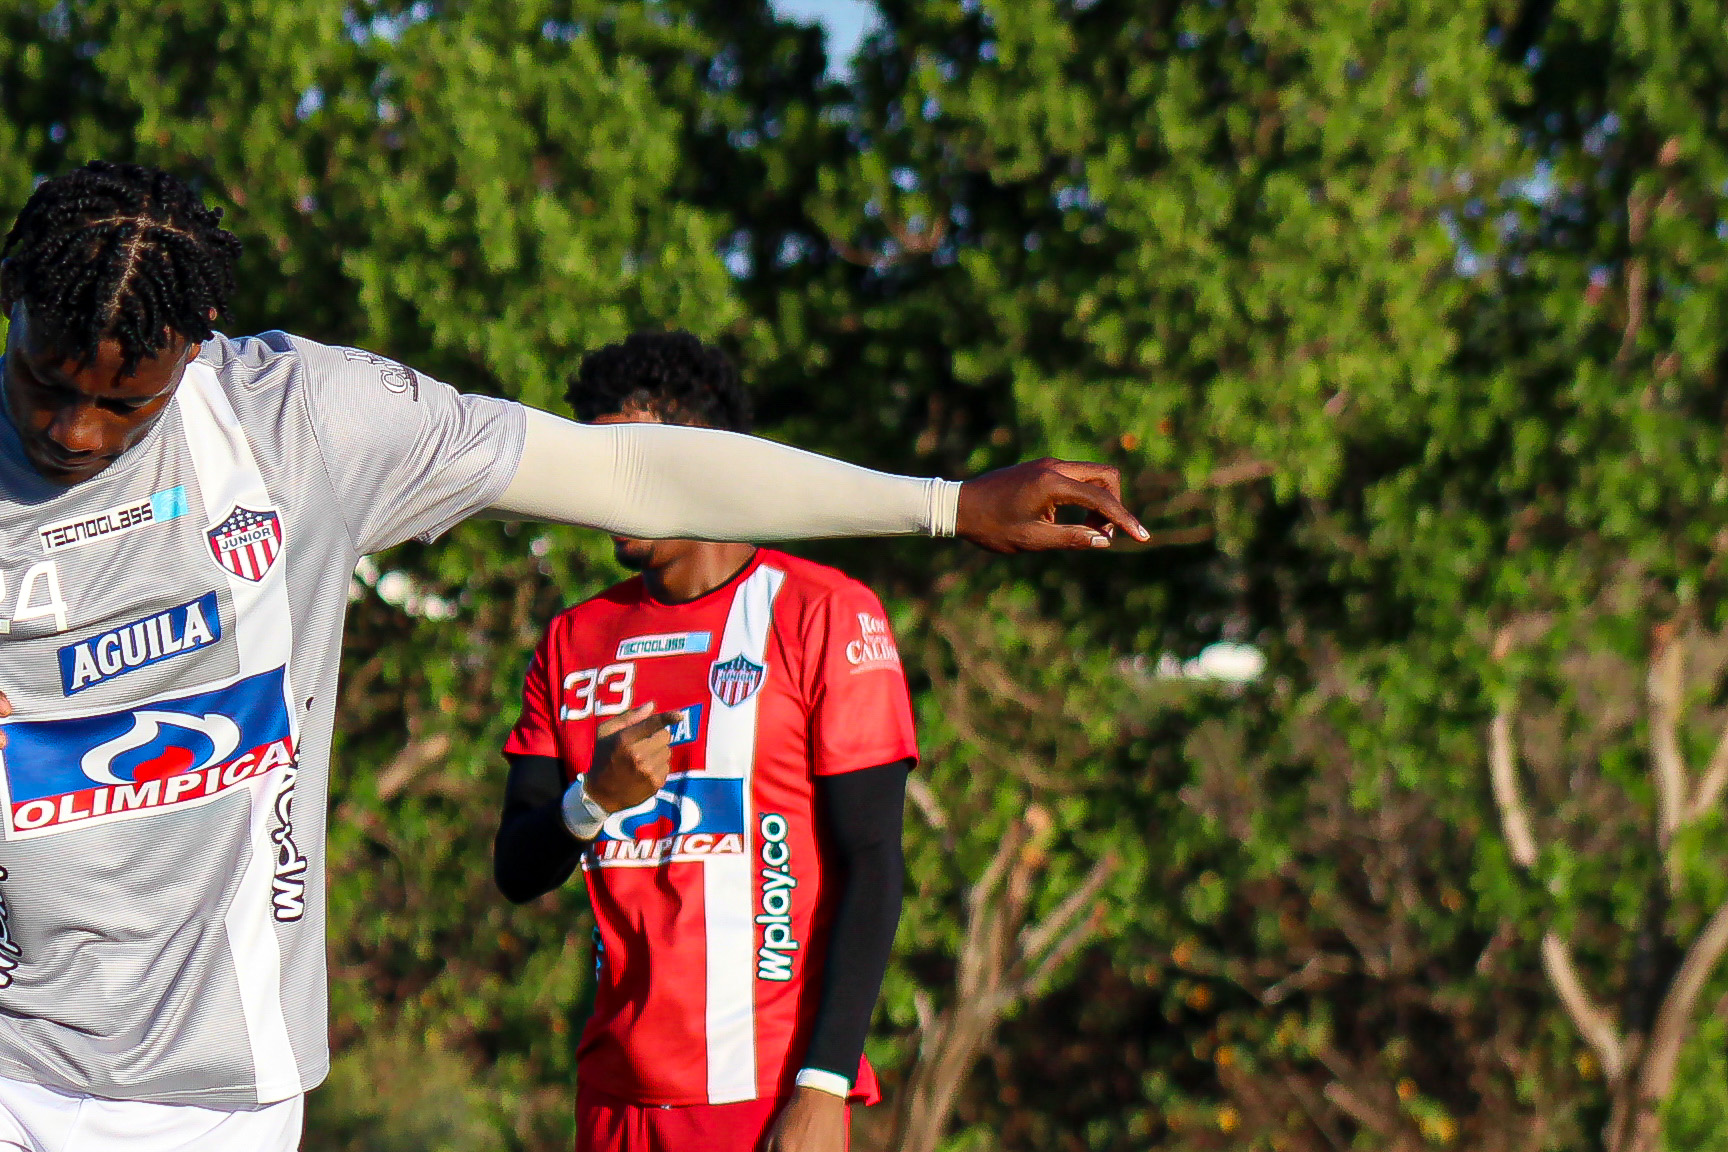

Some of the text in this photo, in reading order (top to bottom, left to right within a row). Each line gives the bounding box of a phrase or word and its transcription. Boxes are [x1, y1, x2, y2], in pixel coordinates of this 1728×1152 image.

[220, 526, 272, 551] JUNIOR
[70, 601, 214, 691] AGUILA
[560, 662, 636, 721] 33
[13, 740, 294, 830] OLIMPICA
[601, 833, 743, 860] IMPICA
[755, 812, 800, 982] Wplay.co
